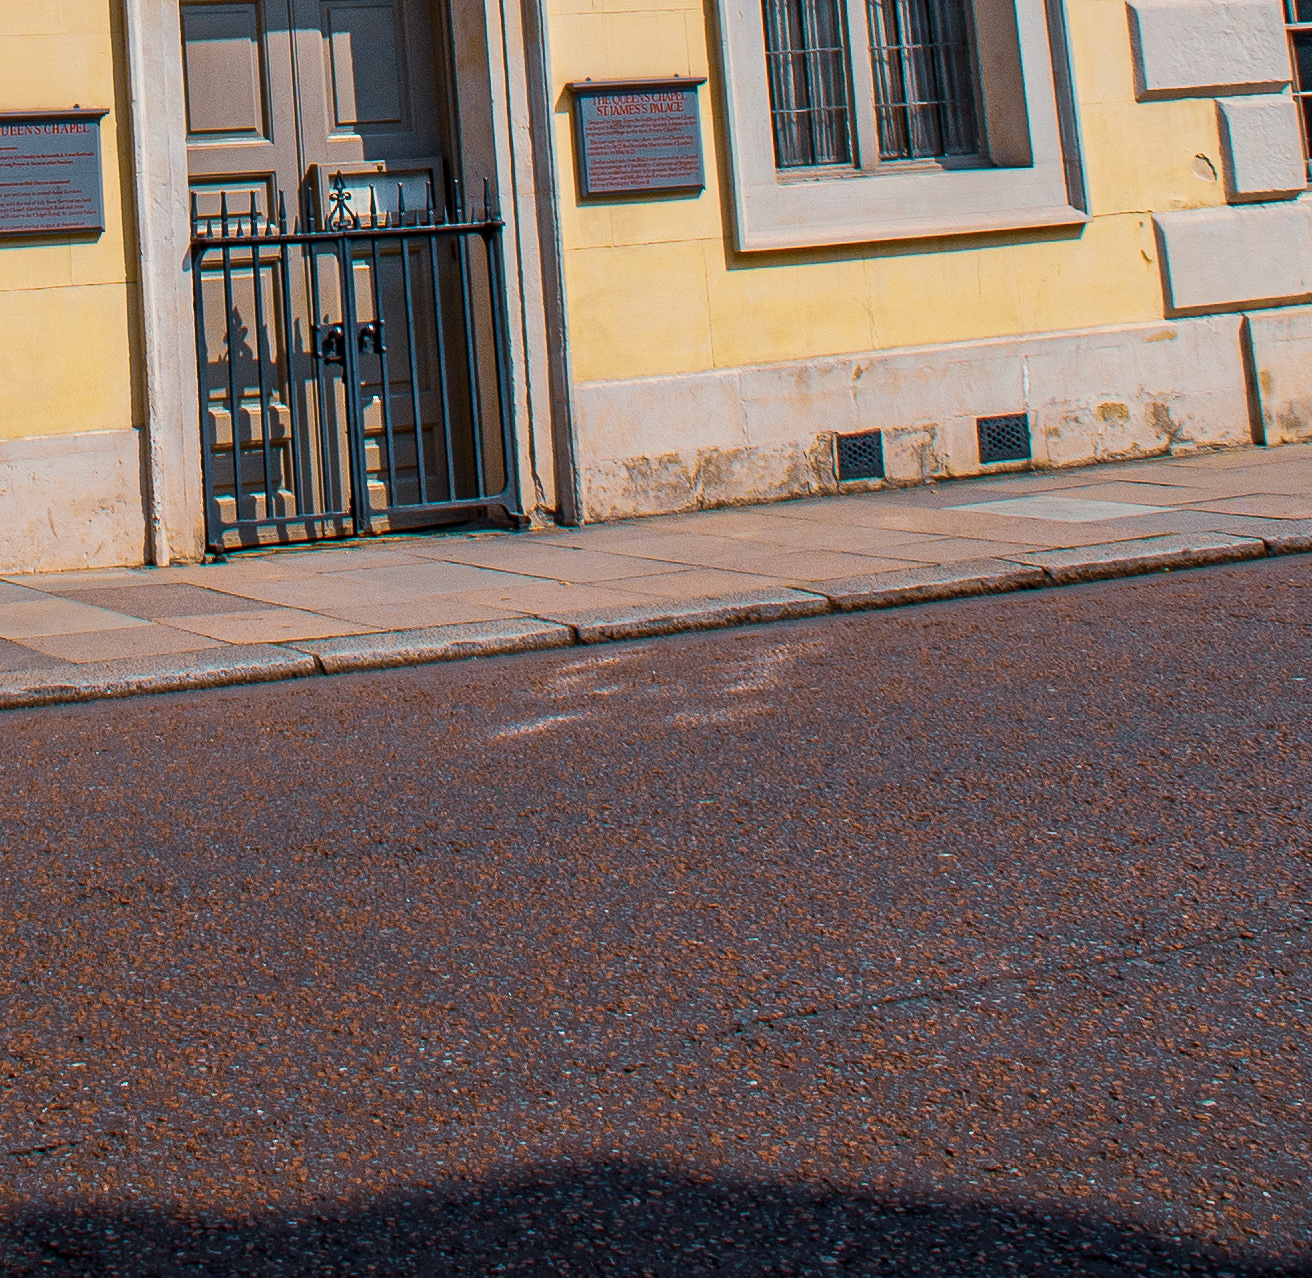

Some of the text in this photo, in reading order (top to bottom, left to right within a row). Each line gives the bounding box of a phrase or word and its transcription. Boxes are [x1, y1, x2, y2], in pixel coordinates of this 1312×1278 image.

[592, 96, 610, 105] THE
[651, 92, 686, 102] CHAPEL
[650, 102, 683, 114] PALACE
[43, 123, 89, 135] CHAPEL
